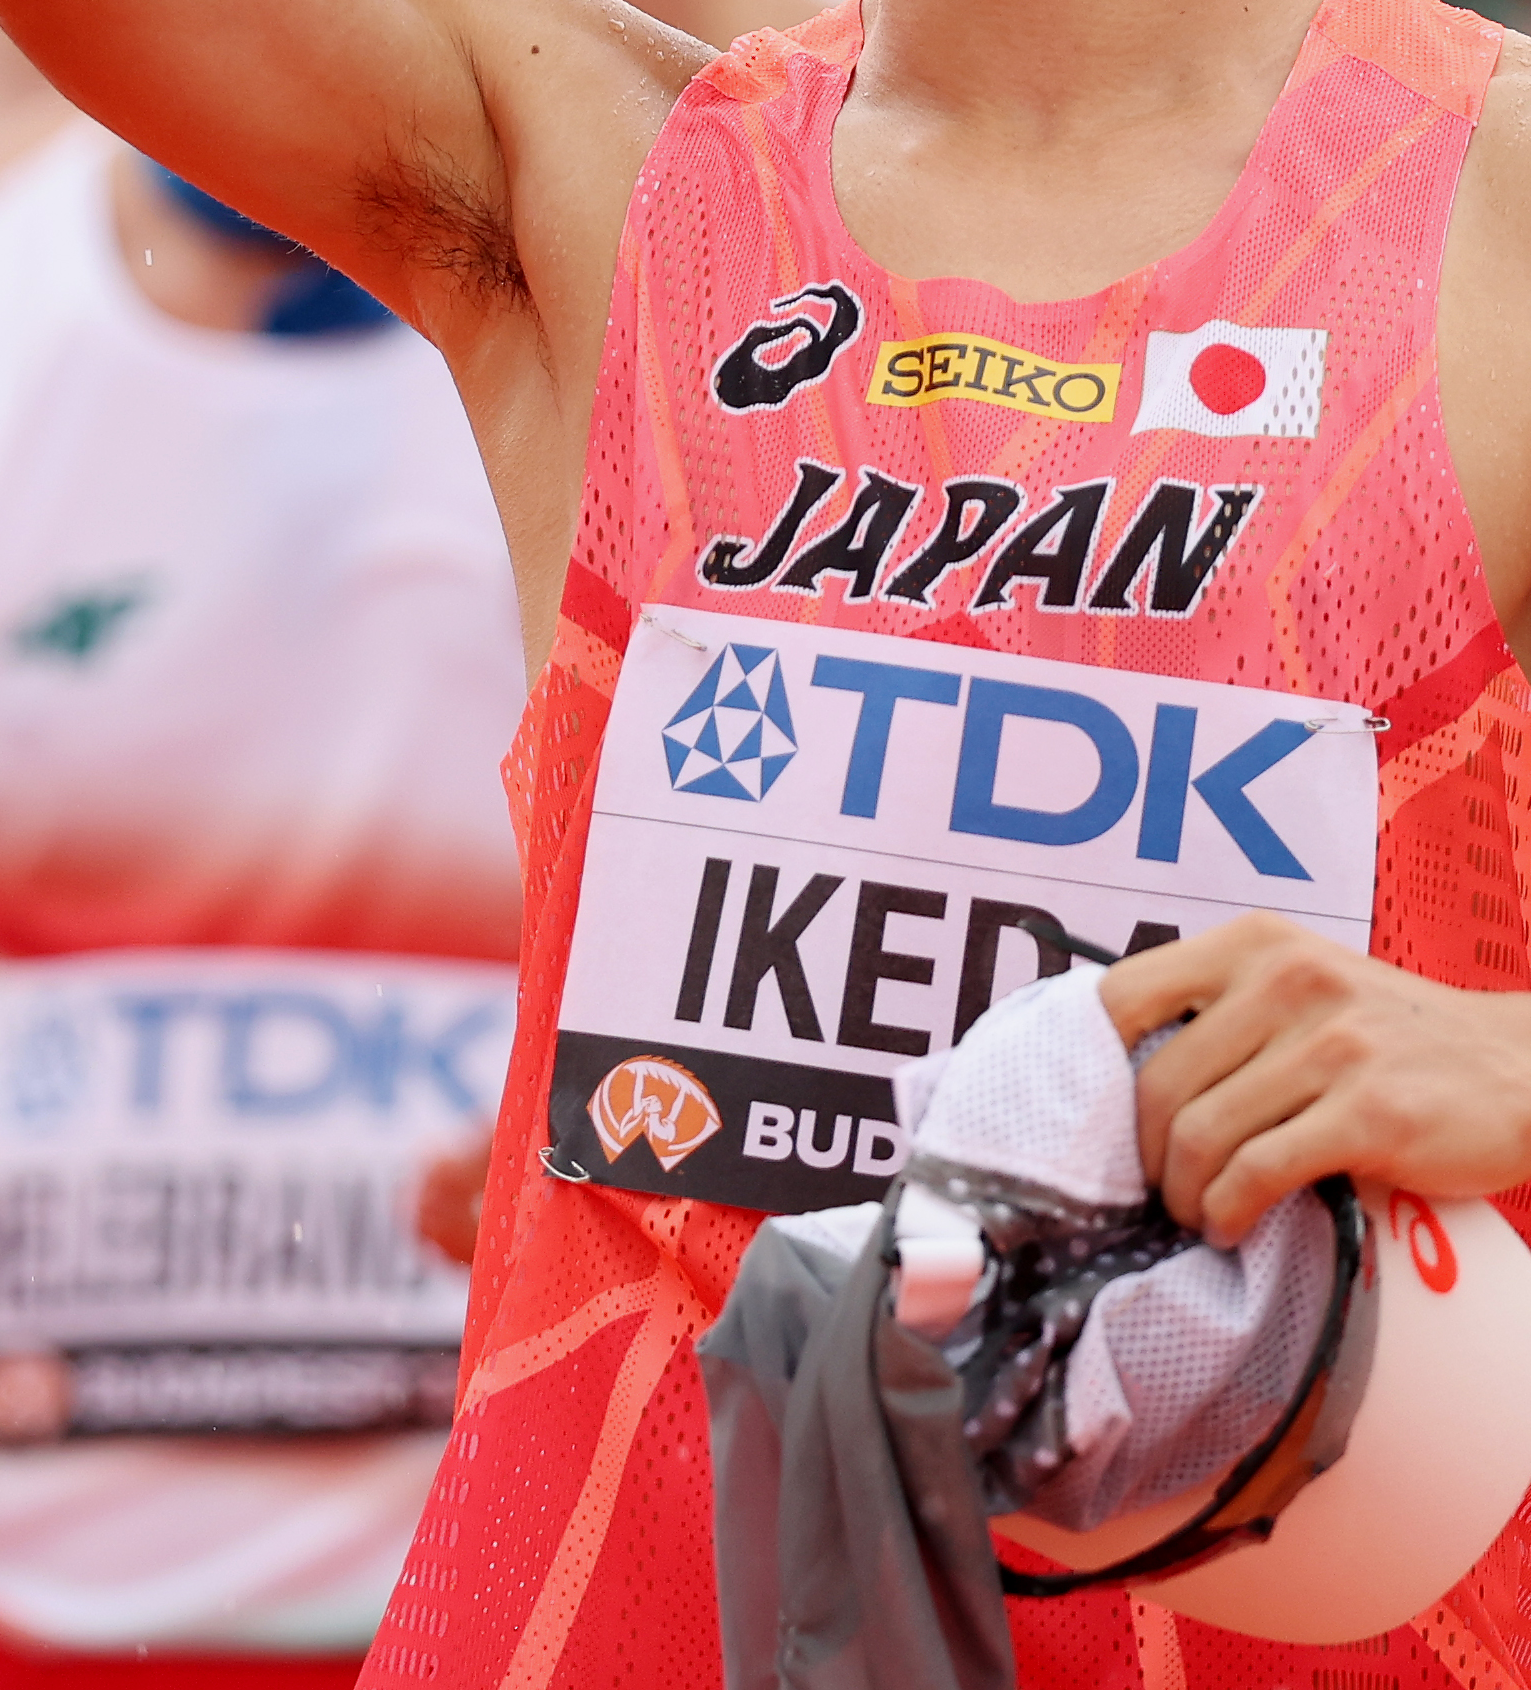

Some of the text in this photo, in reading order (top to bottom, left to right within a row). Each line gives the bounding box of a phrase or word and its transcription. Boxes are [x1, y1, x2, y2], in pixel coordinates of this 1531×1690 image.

[880, 343, 1107, 413] SEIKO
[696, 456, 1265, 618] JAPAN
[810, 654, 1324, 882] TDK
[674, 856, 1180, 1057] IKED
[111, 990, 503, 1116] TDK
